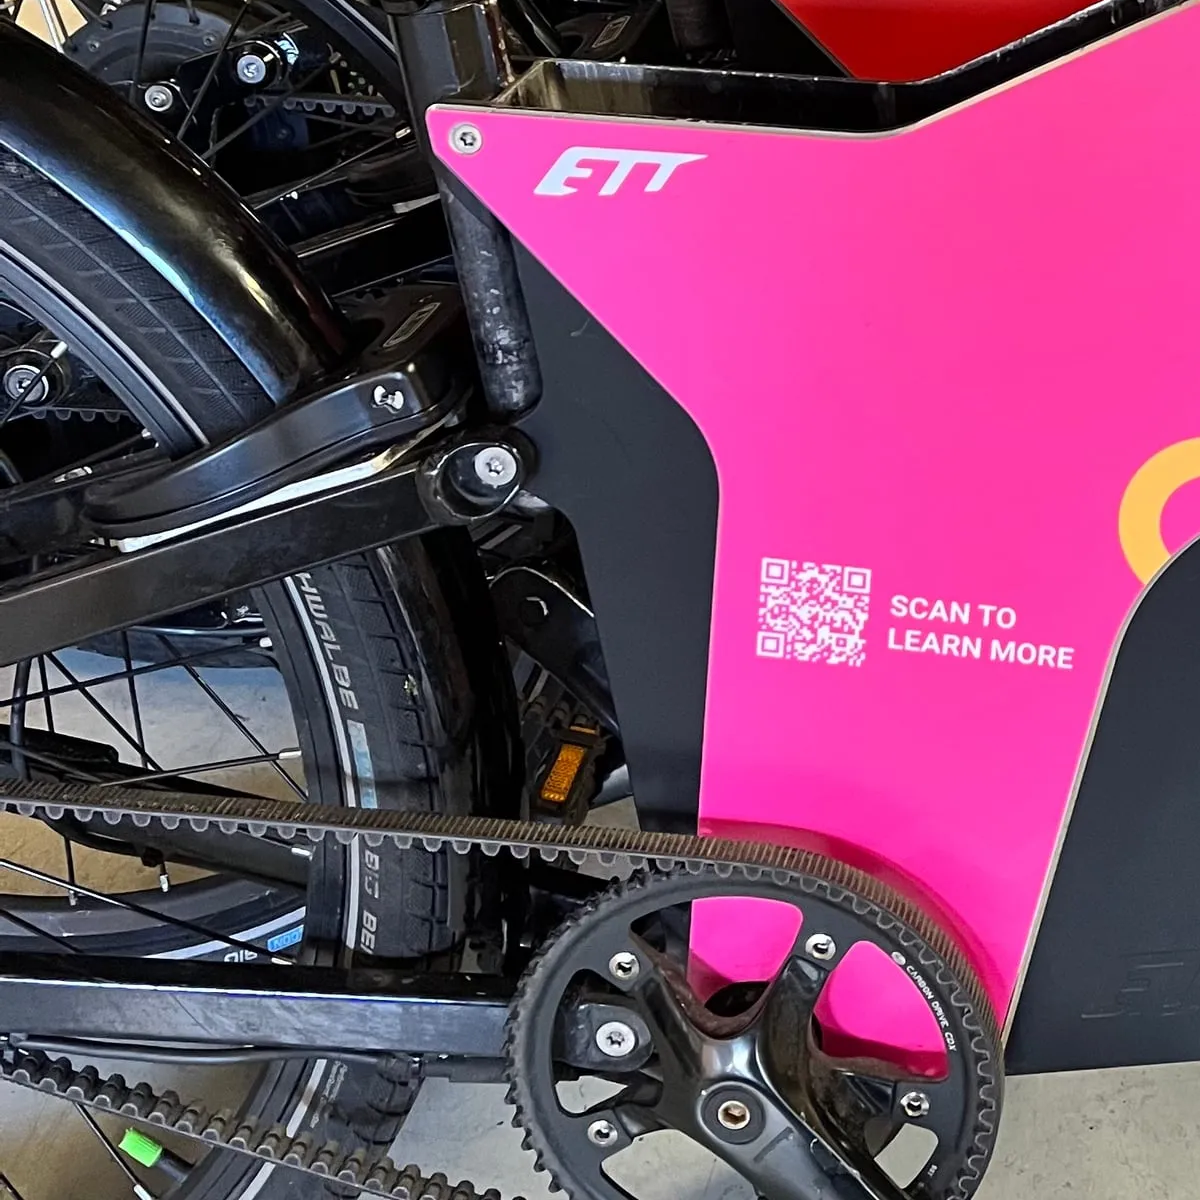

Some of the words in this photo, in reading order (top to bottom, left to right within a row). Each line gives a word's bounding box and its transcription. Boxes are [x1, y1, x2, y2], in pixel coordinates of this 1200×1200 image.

[533, 146, 706, 196] ETT
[890, 595, 970, 624] SCAN
[978, 604, 1017, 629] TO
[296, 572, 359, 711] HWALBE
[888, 628, 983, 660] LEARN
[990, 639, 1074, 669] MORE
[906, 965, 935, 1000] CARBON
